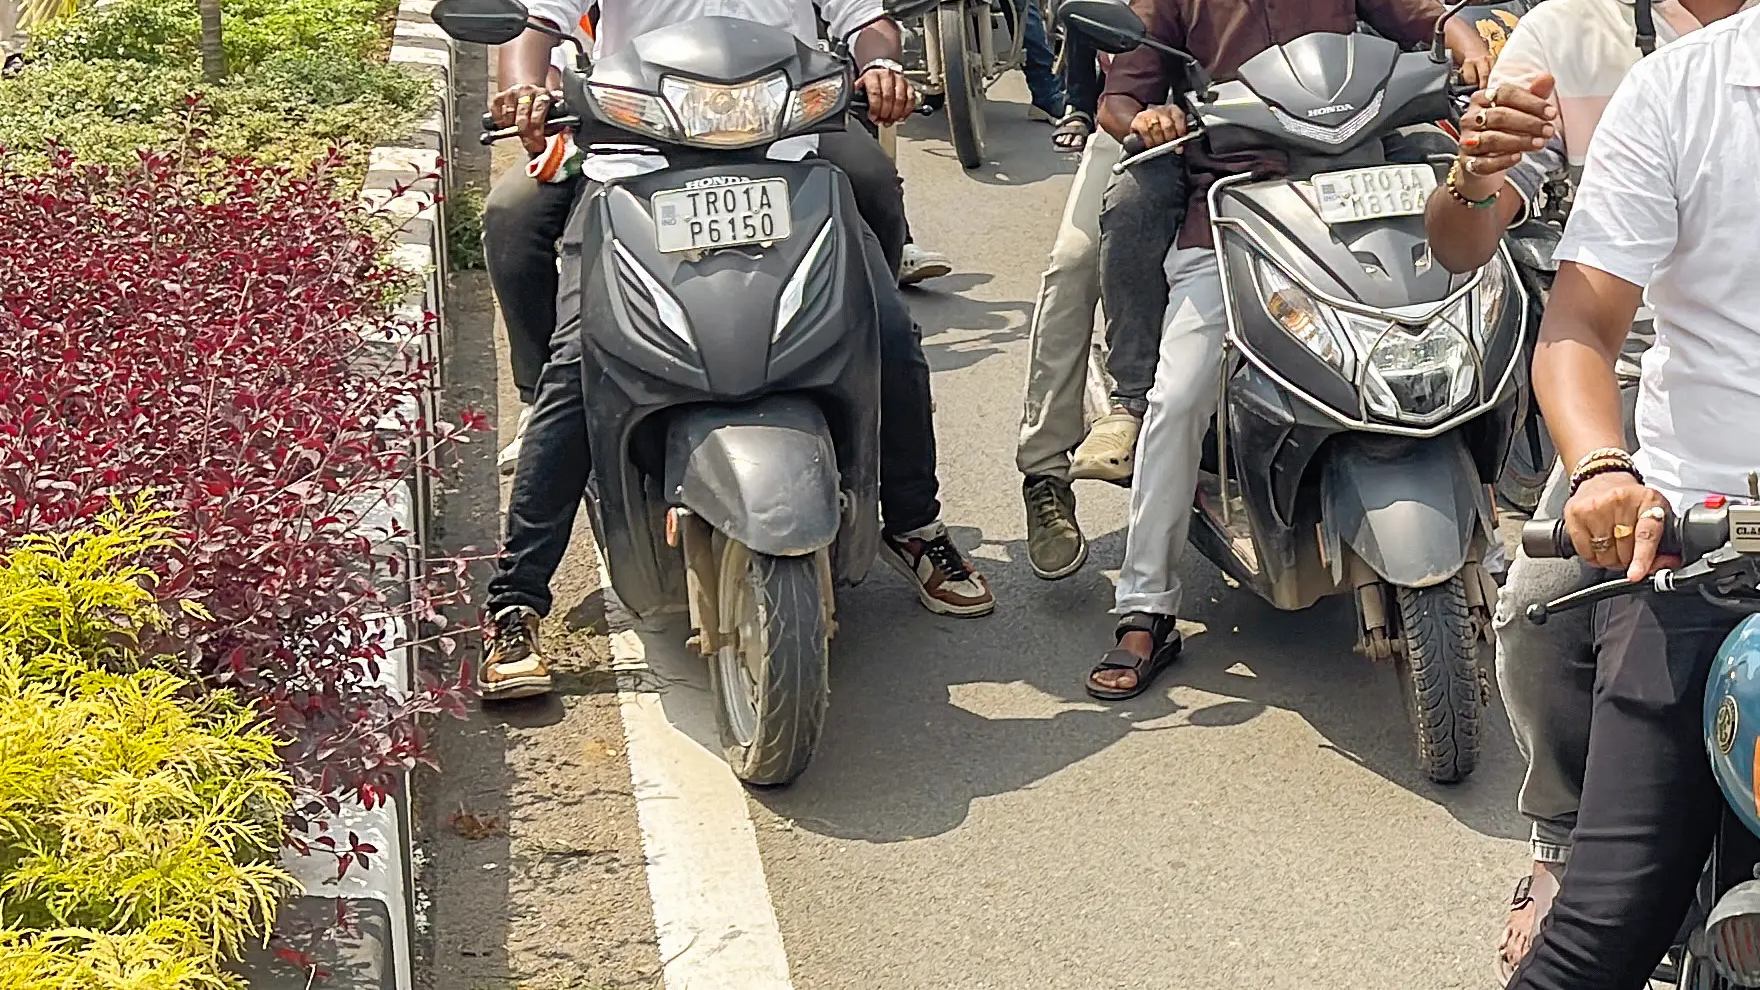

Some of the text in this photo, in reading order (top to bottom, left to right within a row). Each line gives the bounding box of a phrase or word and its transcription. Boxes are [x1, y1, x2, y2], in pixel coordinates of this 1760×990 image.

[1307, 103, 1355, 118] HONDA
[686, 185, 772, 218] TR01A
[690, 213, 775, 247] P6150
